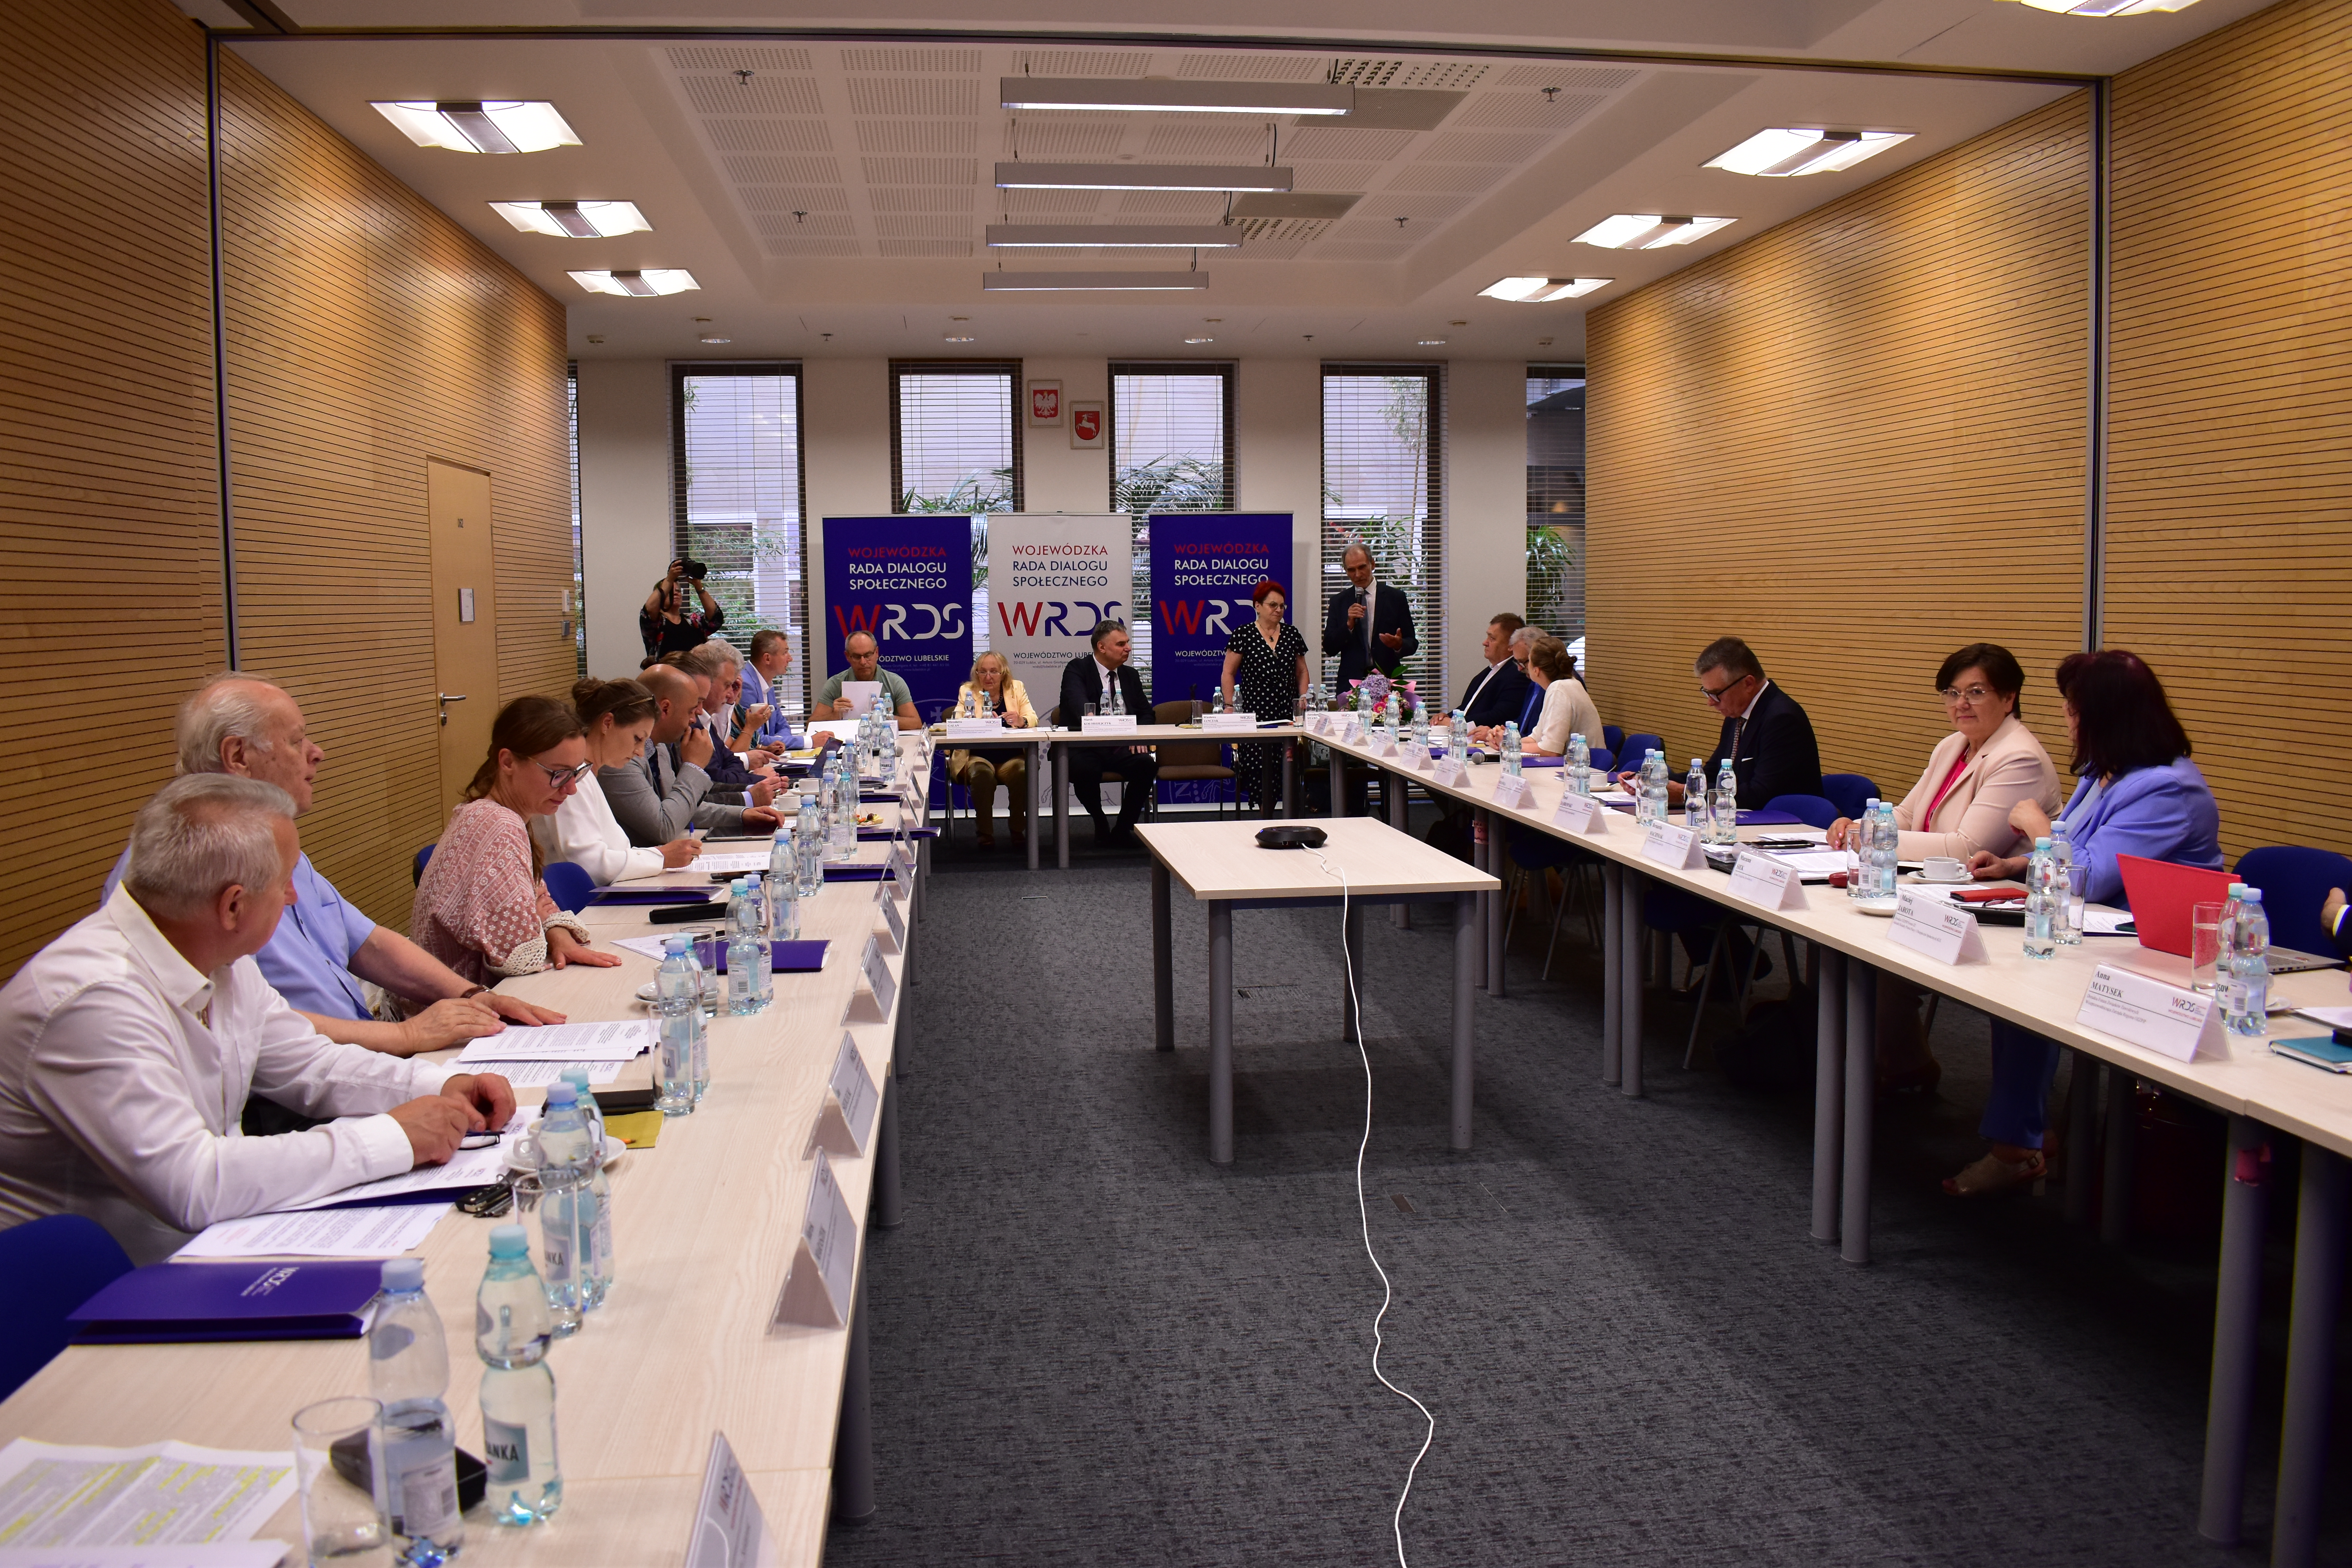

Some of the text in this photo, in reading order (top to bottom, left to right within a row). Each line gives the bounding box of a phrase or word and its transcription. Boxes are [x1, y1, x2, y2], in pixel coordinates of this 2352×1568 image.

[848, 544, 947, 557] WOJEWÓDZKA
[1013, 543, 1108, 555] WOJEWÓDZKA
[1174, 541, 1269, 554] WOJEWÓDZKA
[849, 562, 946, 574] RADA DIALOGU
[1013, 561, 1107, 571] RADA DIALOGU
[1175, 559, 1269, 570] RADA DIALOGU
[849, 578, 947, 590] SPOŁECZNEGO
[1013, 576, 1108, 586] SPOŁECZNEGO
[1175, 574, 1269, 585] SPOŁECZNEGO
[834, 603, 964, 640] WRDS
[1902, 894, 1913, 905] Maciej
[1898, 905, 1959, 926] JAROTA WRDS
[2095, 971, 2110, 981] Anna
[2091, 981, 2124, 998] MATYSEK
[2172, 997, 2196, 1012] WRDS
[485, 1440, 519, 1462] ANKA
